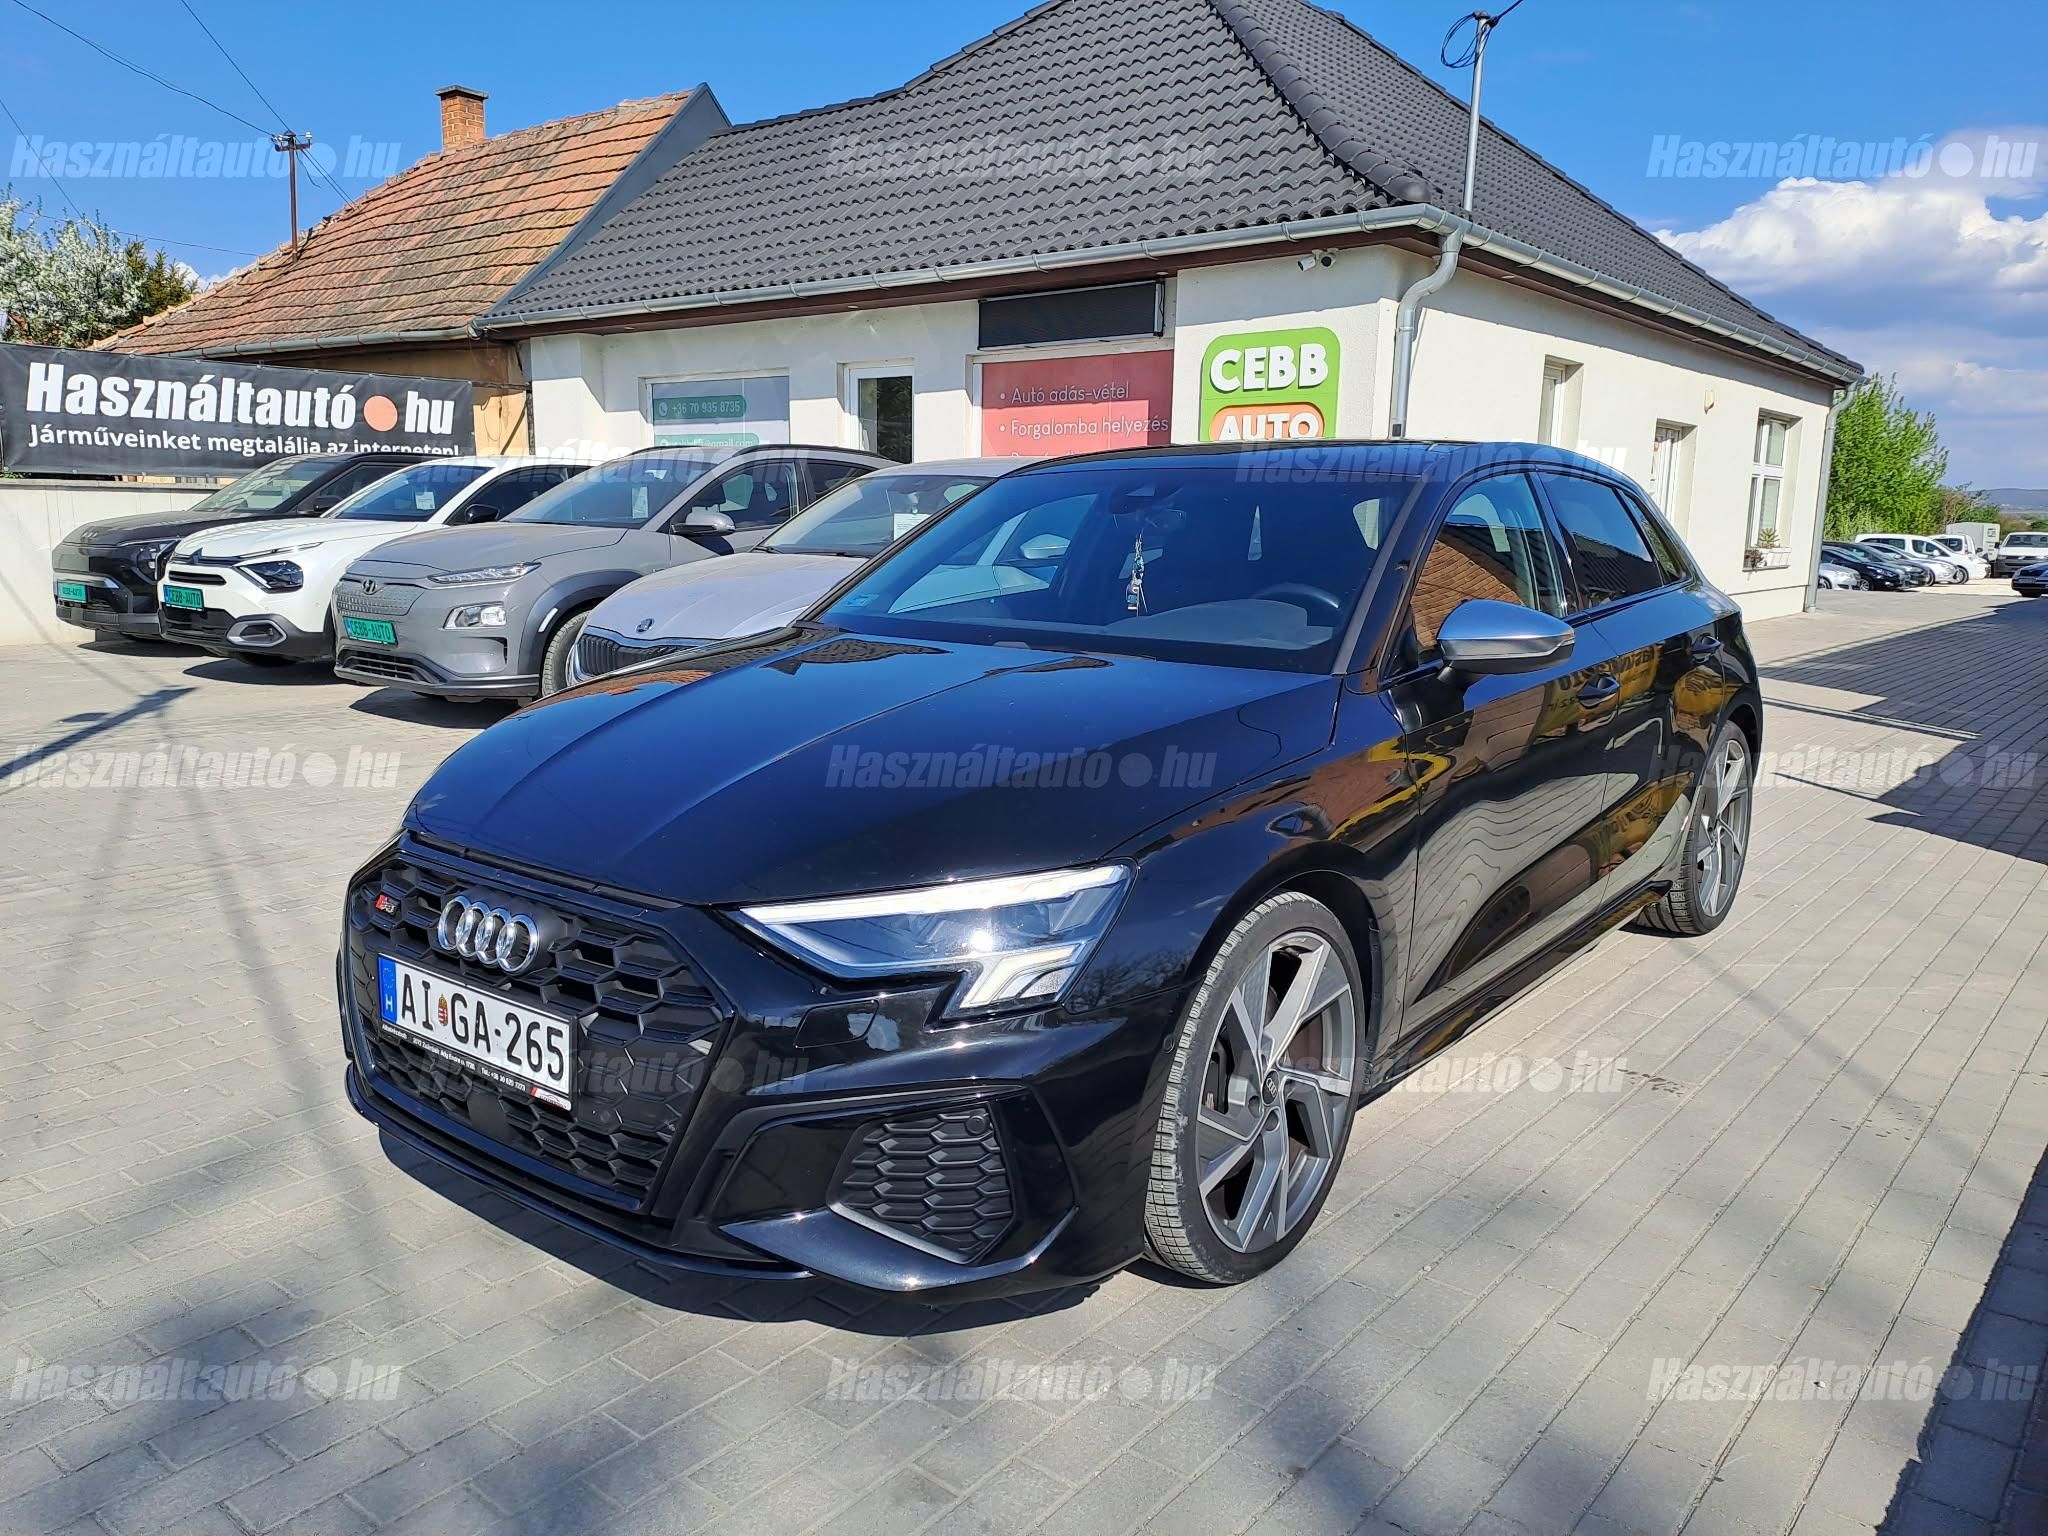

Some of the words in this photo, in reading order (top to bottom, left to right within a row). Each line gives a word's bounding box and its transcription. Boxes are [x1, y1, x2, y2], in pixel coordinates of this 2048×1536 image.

[1209, 343, 1328, 393] CEBB
[1011, 387, 1045, 404] Autó
[1050, 381, 1129, 402] adás-vétel
[672, 402, 687, 416] +36
[690, 402, 699, 413] 70
[702, 401, 718, 413] 935
[28, 424, 201, 450] Járműveinket
[327, 441, 348, 453] az
[1011, 418, 1098, 440] Forgalomba
[1102, 415, 1169, 438] helyezés
[1218, 412, 1319, 440] AUTO
[350, 620, 391, 640] CEBB-AUTO
